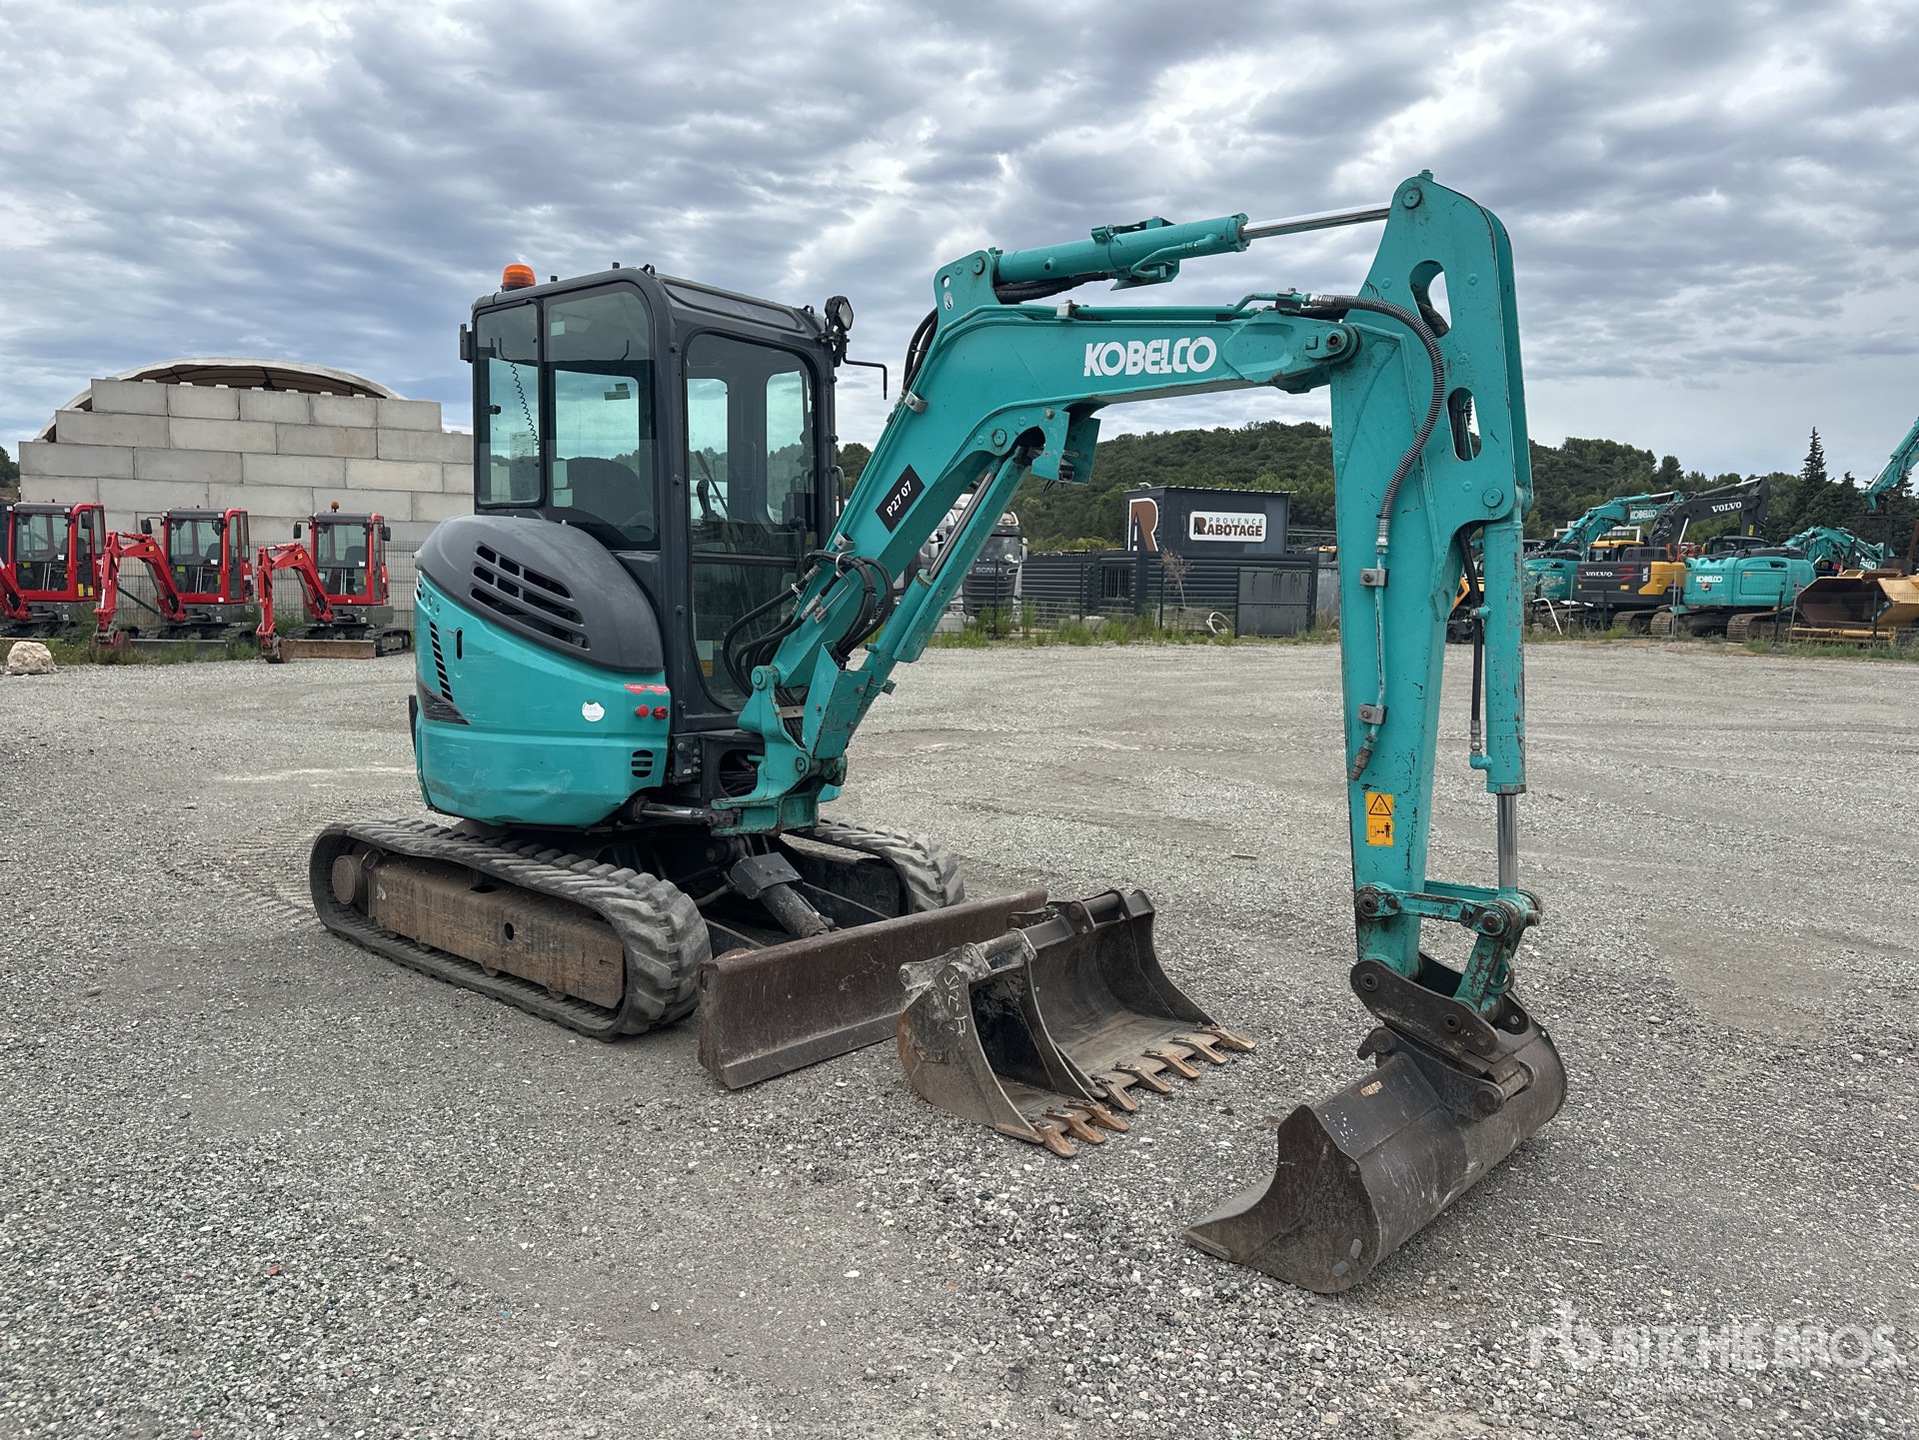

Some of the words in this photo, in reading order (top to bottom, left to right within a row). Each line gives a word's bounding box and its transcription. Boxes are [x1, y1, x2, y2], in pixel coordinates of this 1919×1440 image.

[1083, 336, 1217, 377] KOBELCO
[886, 493, 902, 517] P27
[900, 480, 912, 497] 07
[1630, 509, 1658, 520] KOBELCO
[1711, 501, 1742, 513] VOLVO
[1193, 517, 1262, 537] RABOTAGE
[1208, 516, 1263, 526] PROVENCE
